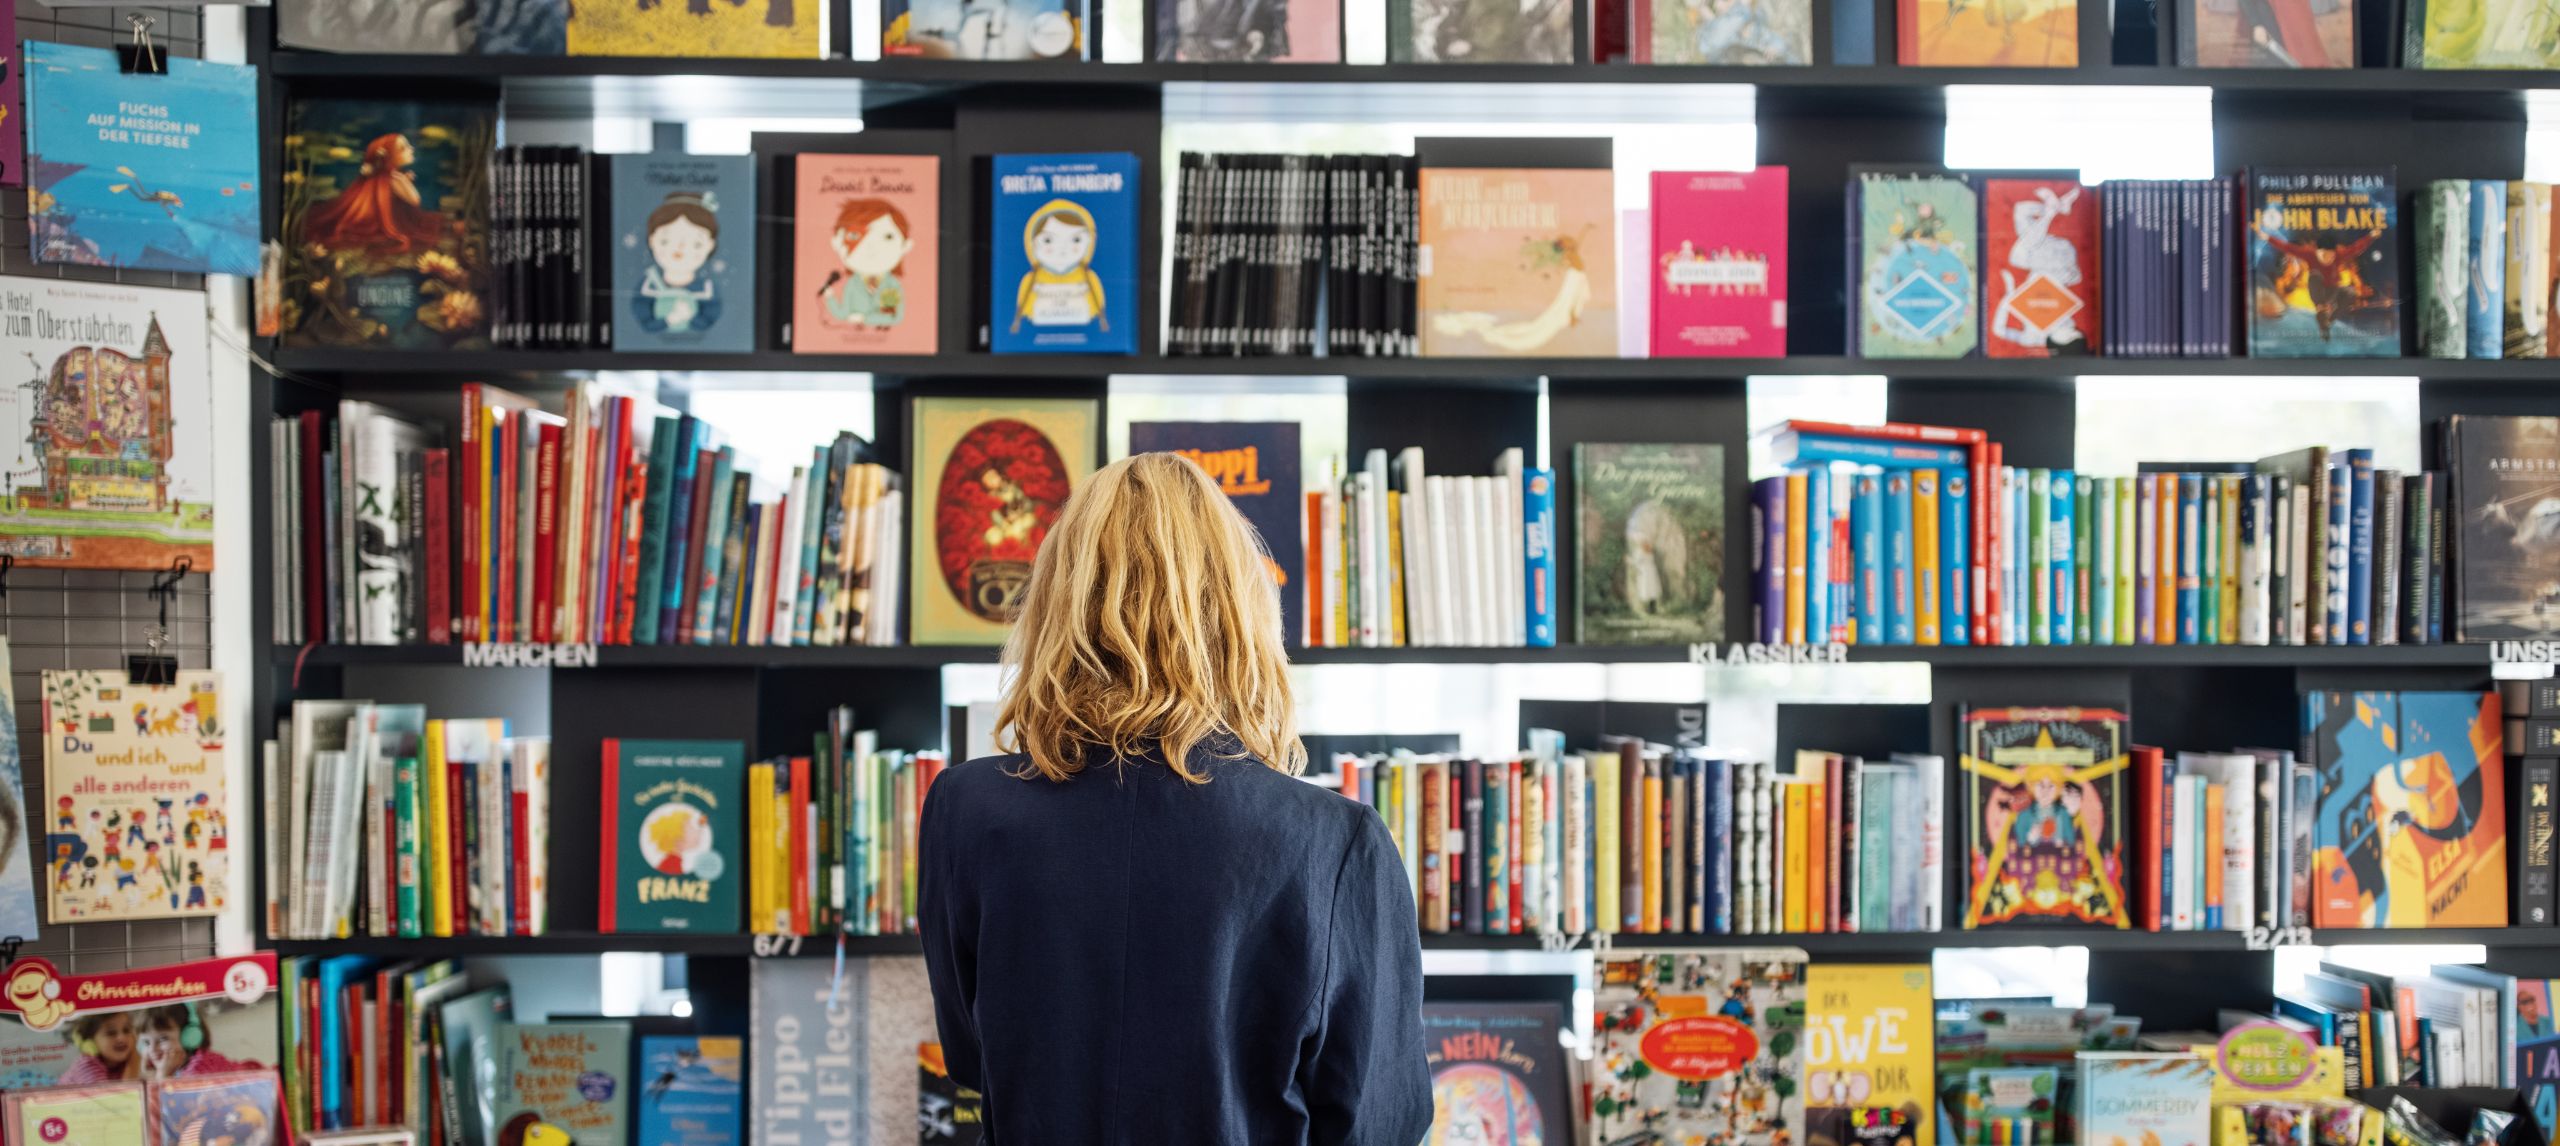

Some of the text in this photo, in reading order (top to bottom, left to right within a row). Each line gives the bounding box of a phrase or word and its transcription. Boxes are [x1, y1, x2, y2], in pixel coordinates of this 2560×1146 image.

[119, 102, 169, 118] FUCHS
[87, 113, 200, 135] AUF MISSION IN
[99, 128, 190, 149] DER TIEFSEE
[2258, 174, 2385, 190] PHILIP PULLMAN
[2266, 193, 2284, 204] DIE
[2287, 193, 2346, 206] ABENTEUER
[2254, 206, 2387, 231] JOHN BLAKE
[7, 290, 33, 313] Hotel
[5, 308, 134, 345] zum Oberstübchen
[2489, 457, 2560, 473] ARMSTR
[1689, 641, 1848, 664] KLASSIKER
[63, 736, 206, 775] Du und ich und
[73, 776, 191, 794] alle anderen
[637, 876, 711, 904] FRANZ
[753, 934, 803, 957] 6/7
[2241, 926, 2314, 951] 12/13
[77, 976, 207, 1000] Ohrwürmchen
[1805, 1007, 1909, 1066] ÖWE
[764, 1014, 811, 1146] Tippo
[1876, 1066, 1911, 1093] DIR
[2095, 1096, 2200, 1116] SOMMERBY
[45, 1121, 64, 1138] 5€
